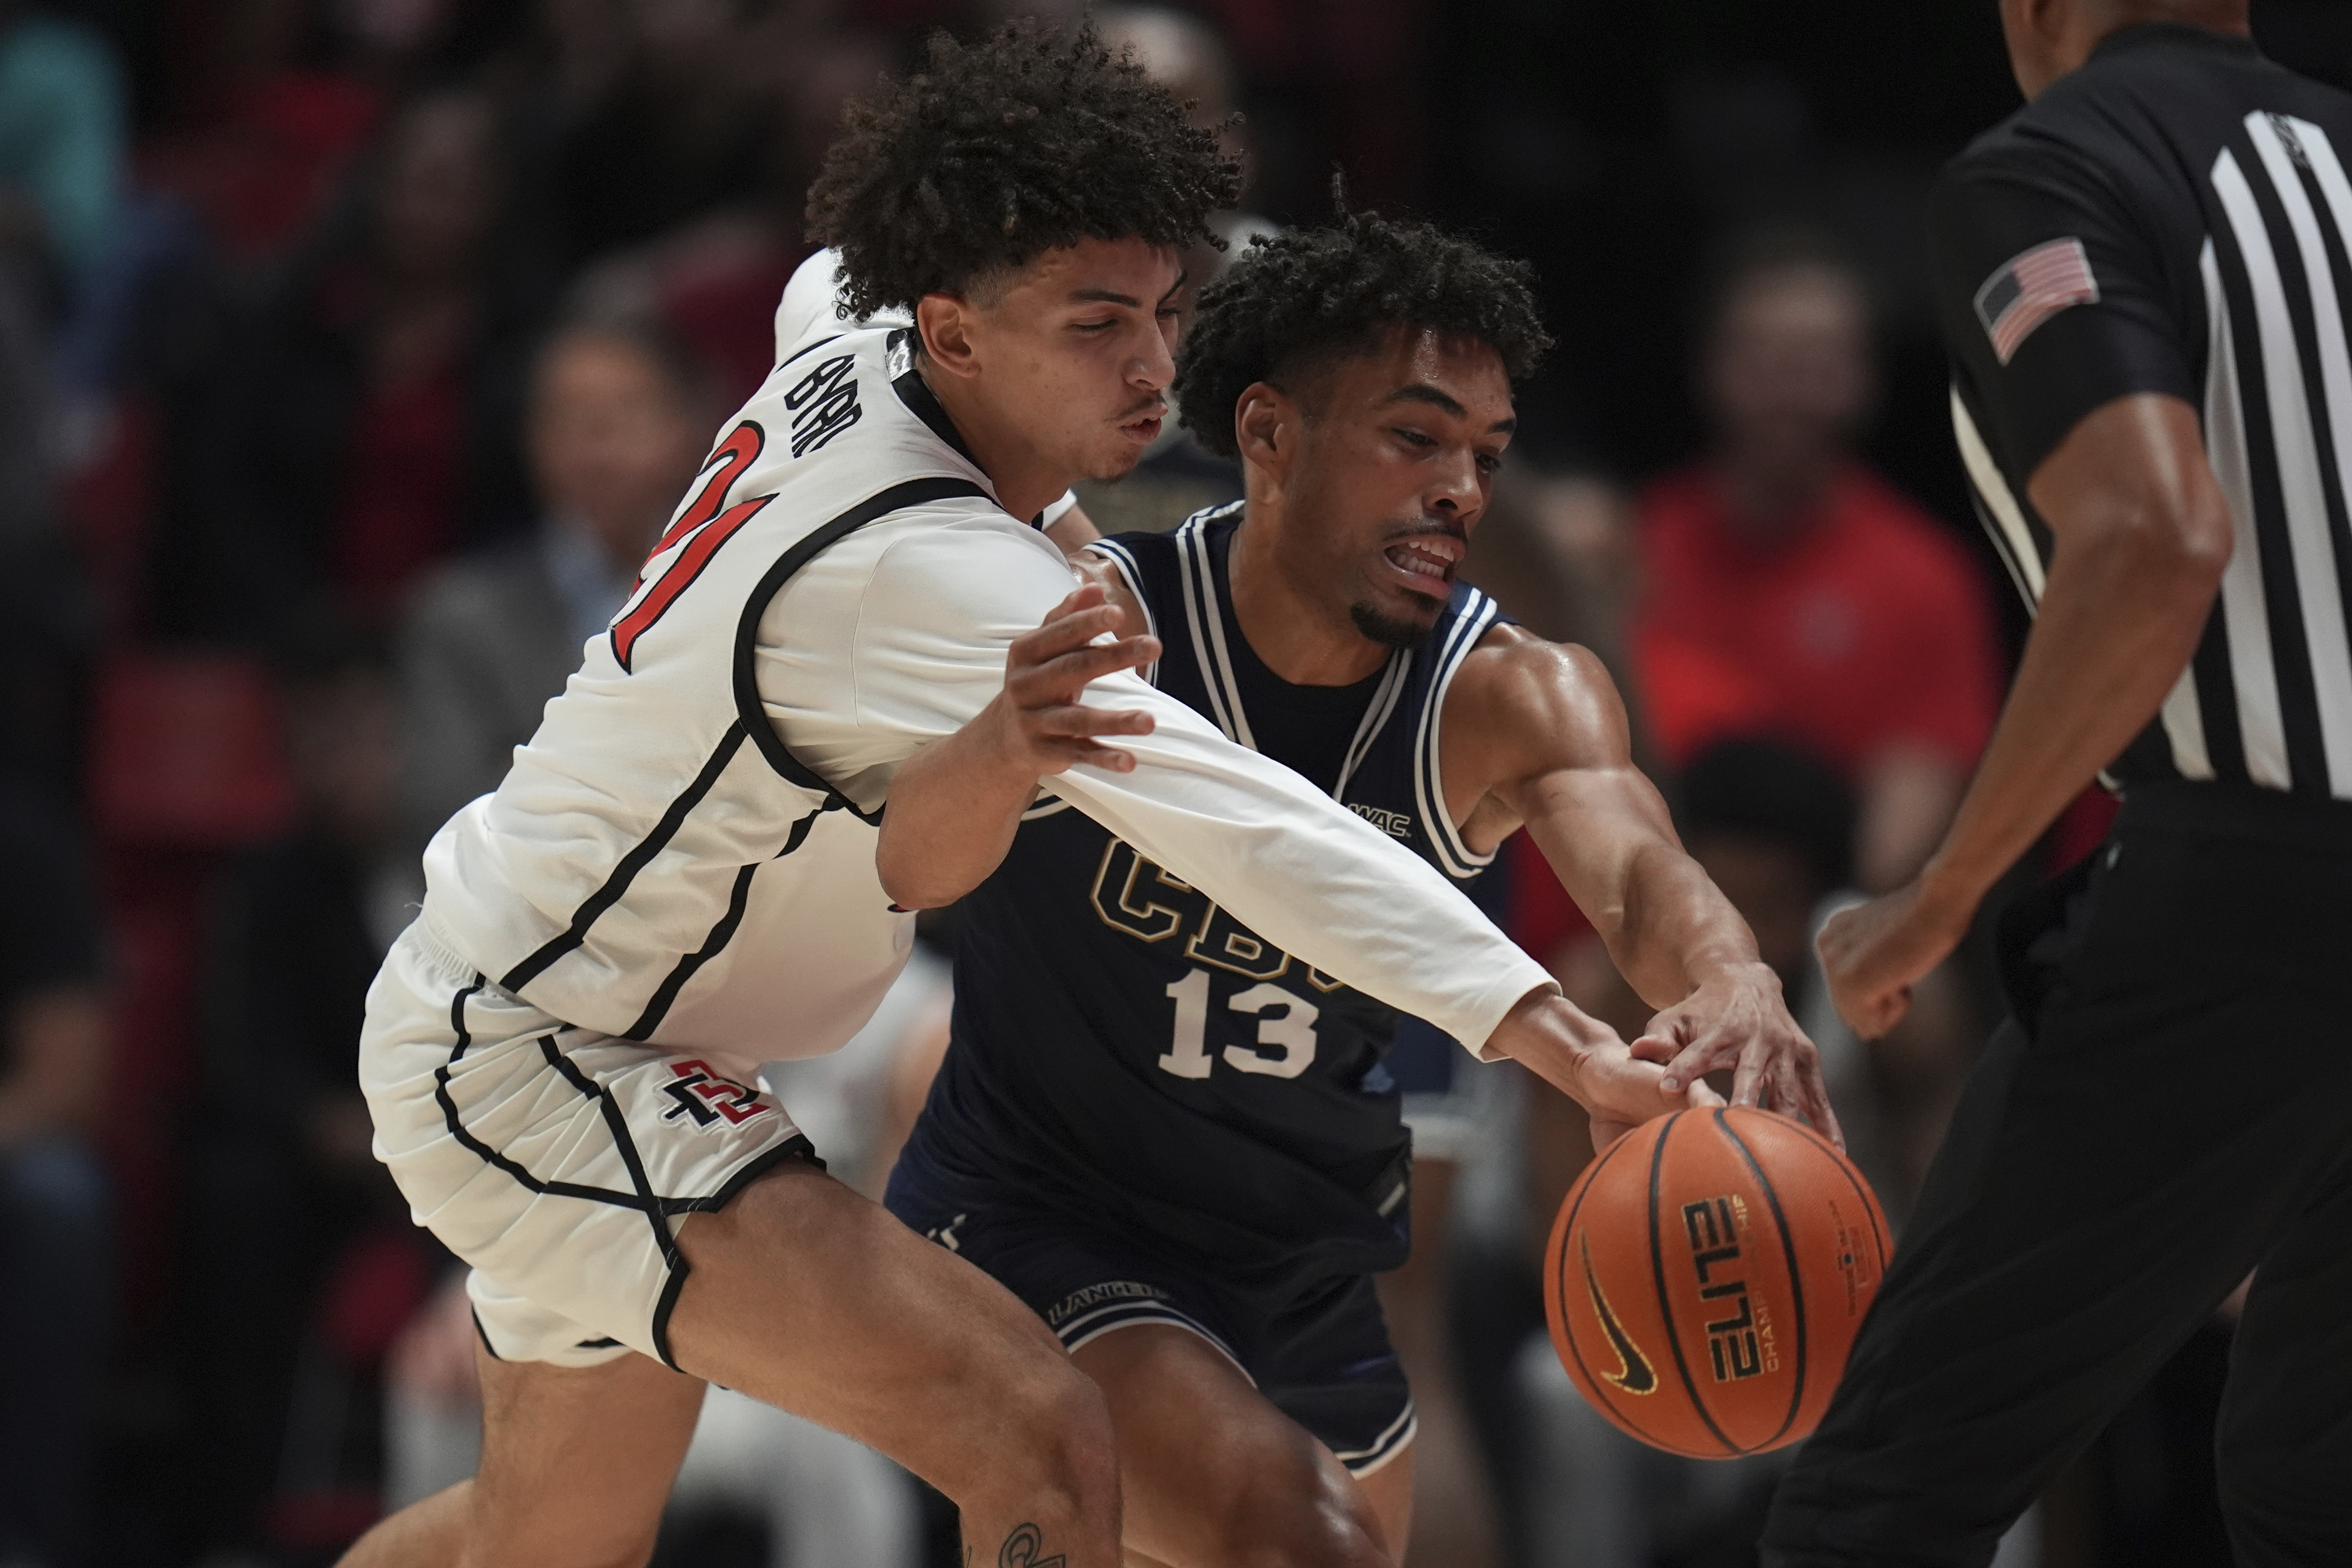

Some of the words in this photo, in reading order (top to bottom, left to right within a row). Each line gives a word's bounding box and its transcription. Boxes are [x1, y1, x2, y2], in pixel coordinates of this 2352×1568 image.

[610, 420, 780, 675] 21
[1090, 837, 1344, 992] CB
[1159, 968, 1319, 1079] 13
[1681, 1194, 1764, 1383] ELITE
